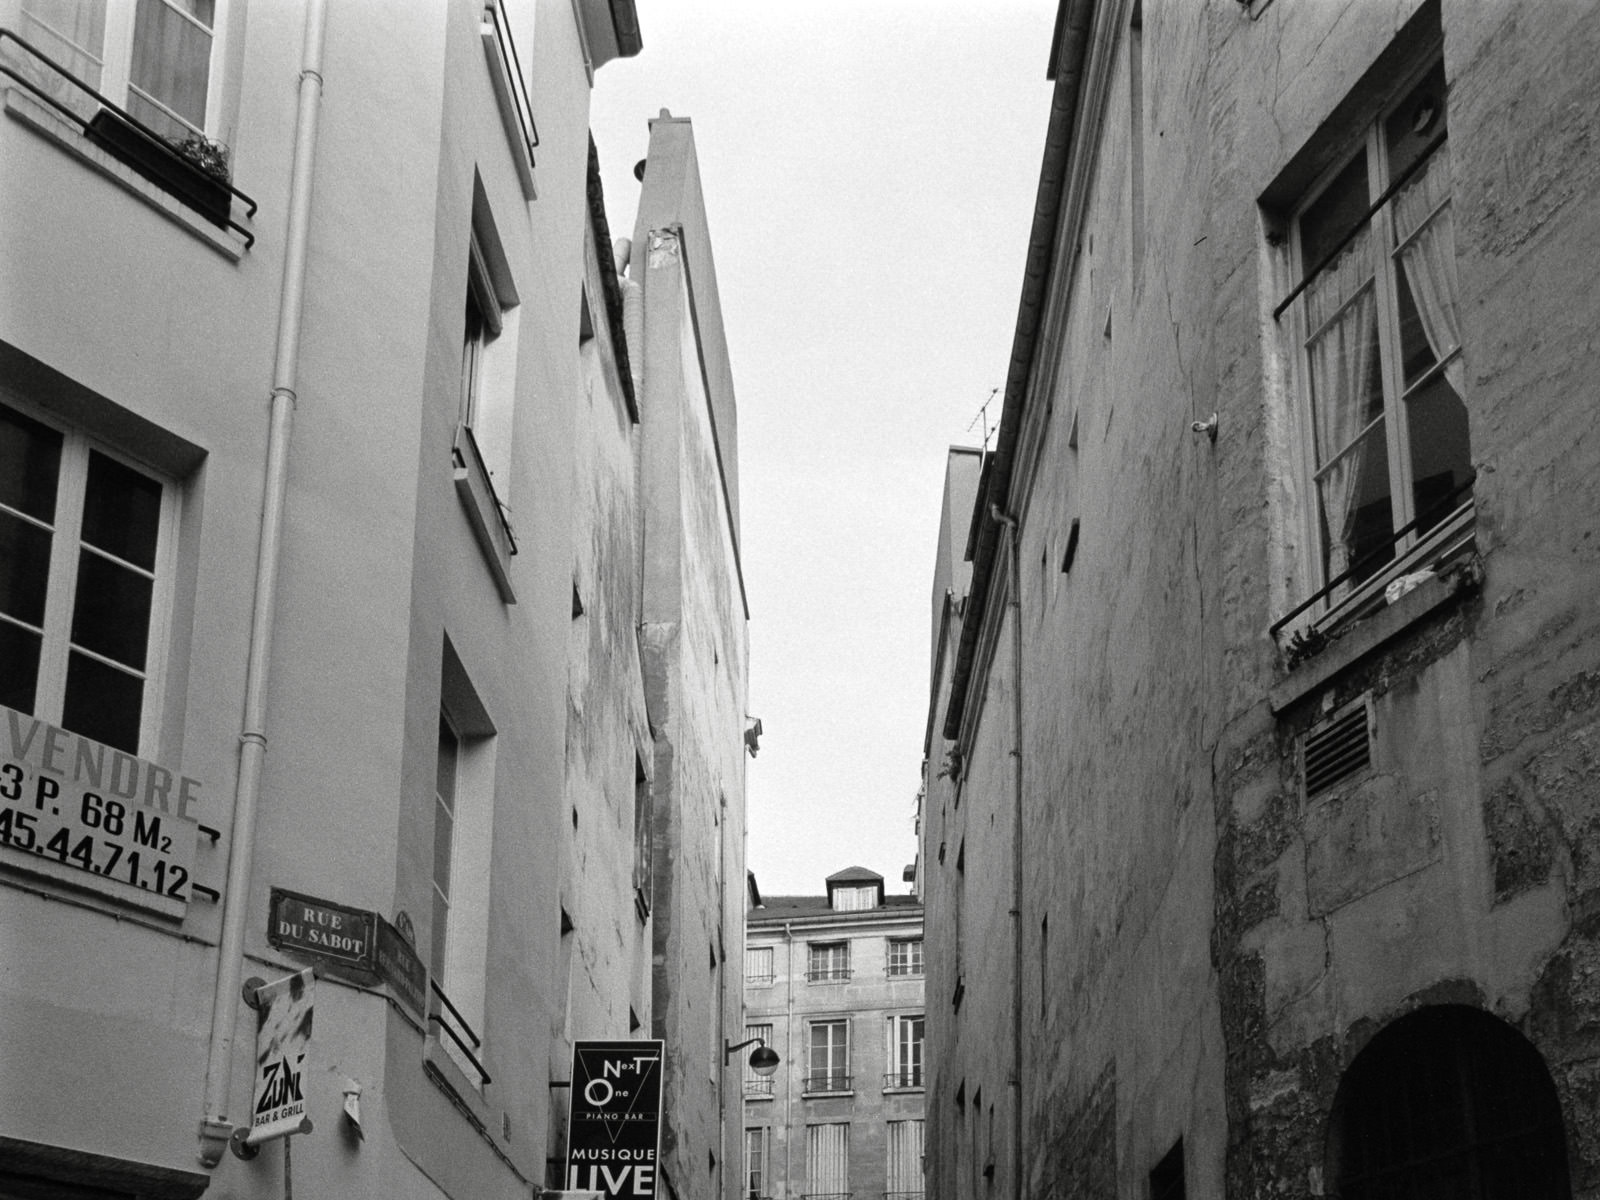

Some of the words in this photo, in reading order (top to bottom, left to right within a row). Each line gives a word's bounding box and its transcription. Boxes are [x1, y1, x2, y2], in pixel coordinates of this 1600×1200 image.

[8, 709, 201, 823] VENDRE
[35, 775, 59, 815] P.
[80, 792, 126, 836] 68
[0, 808, 189, 900] 45.44.71.12
[303, 907, 342, 930] RUE
[279, 920, 304, 939] DU
[308, 929, 363, 954] SABOT
[584, 1078, 629, 1106] One
[255, 1113, 270, 1128] BAR
[272, 1111, 279, 1122] &
[281, 1103, 304, 1119] GRILL
[586, 1112, 619, 1120] PIANO
[625, 1112, 644, 1120] BAR
[571, 1148, 655, 1161] MUSIQUE
[569, 1164, 654, 1196] LIVE
